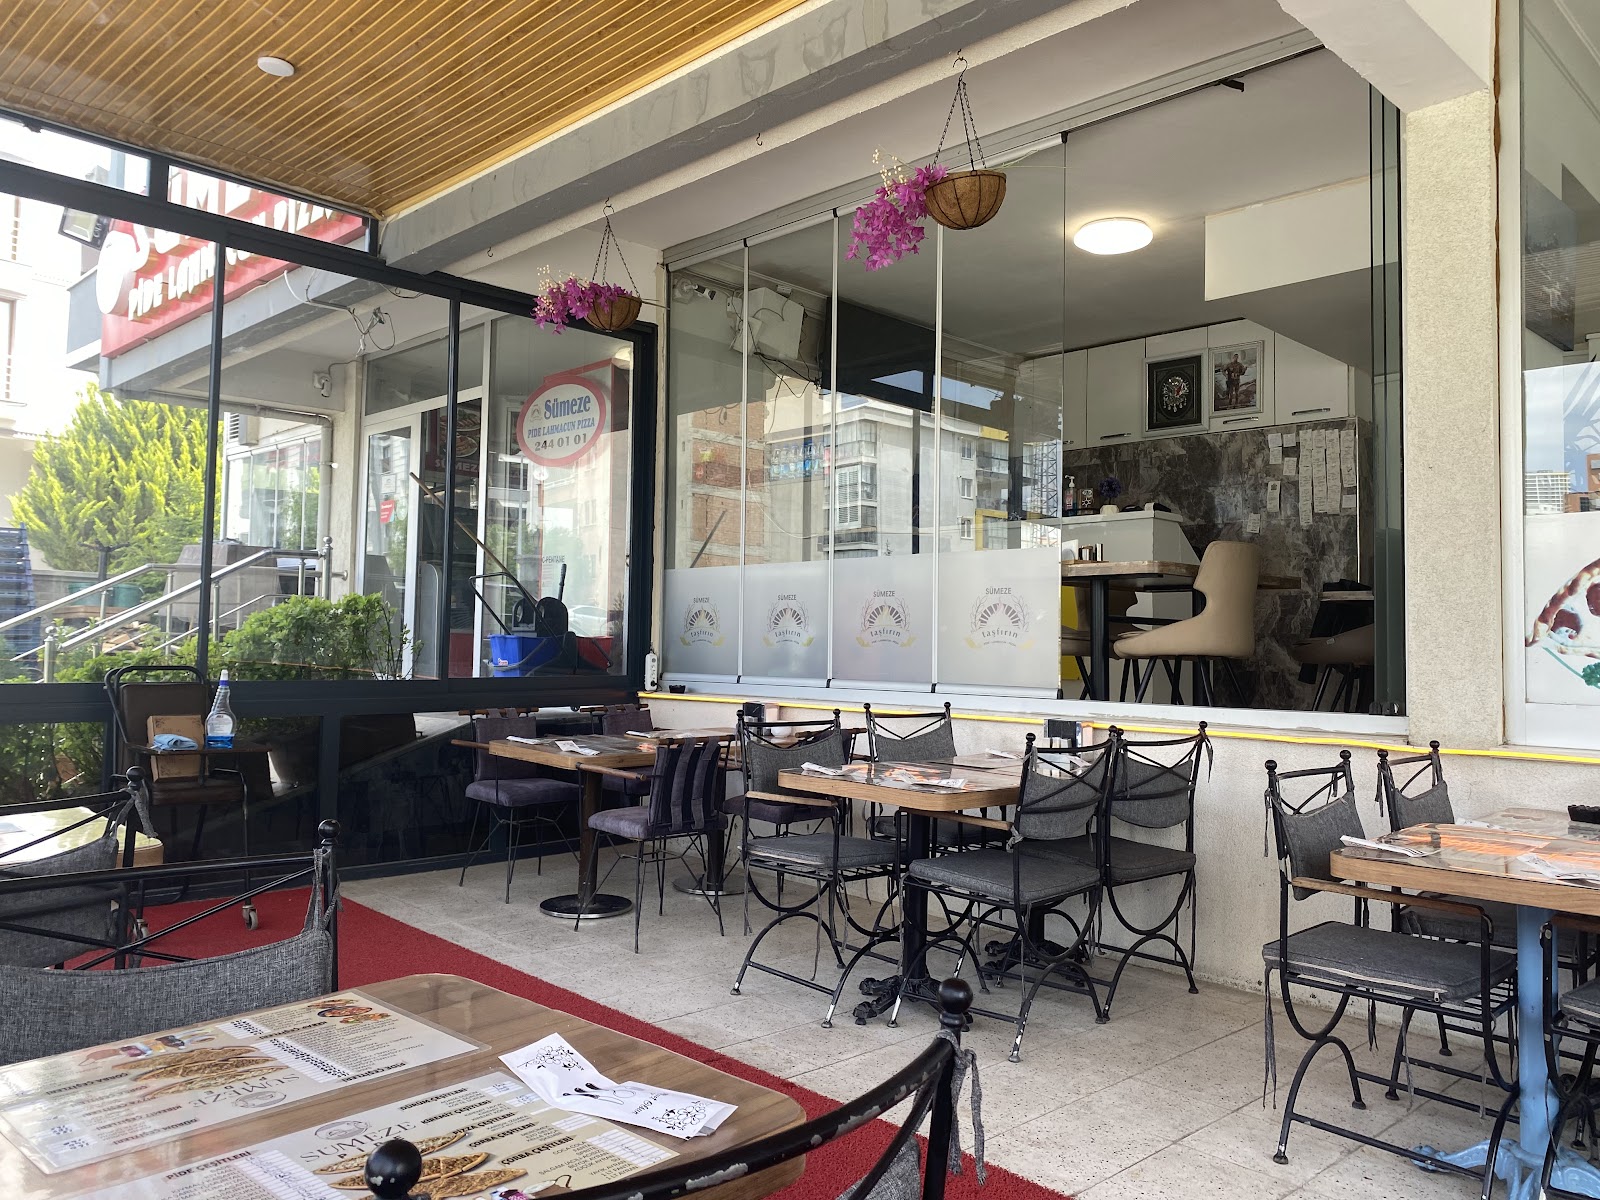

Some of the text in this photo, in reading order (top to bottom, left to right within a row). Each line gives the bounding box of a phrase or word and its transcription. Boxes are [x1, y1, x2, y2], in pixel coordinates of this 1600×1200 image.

[544, 395, 591, 420] Sümeze
[542, 421, 576, 436] LAHMACUN
[577, 417, 595, 429] PİZZA
[535, 433, 587, 451] 244 01 01
[873, 589, 895, 598] SÜMEZE
[985, 586, 1012, 595] SÜMEZE
[501, 1151, 532, 1166] ÇORBA
